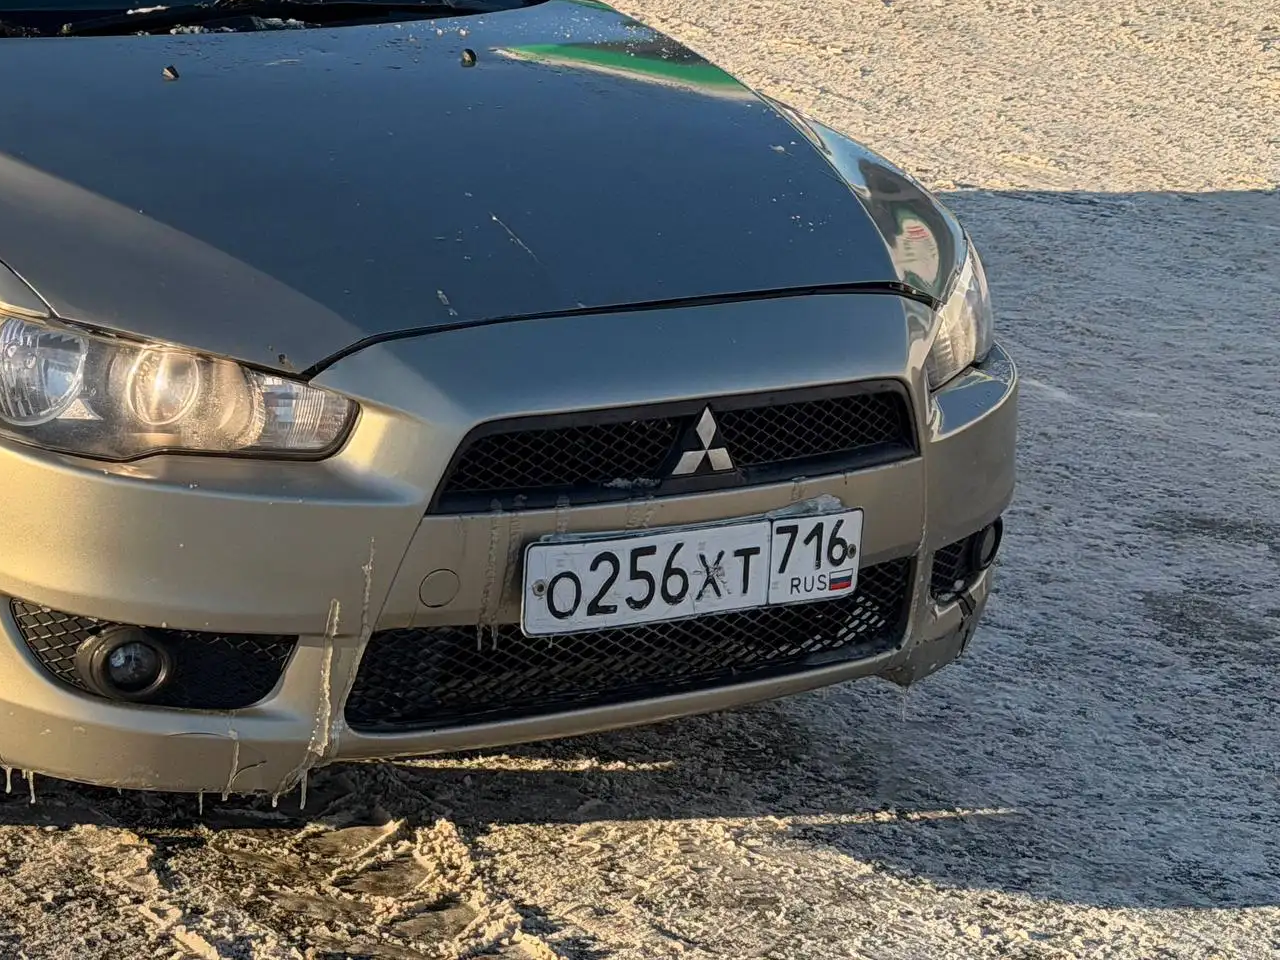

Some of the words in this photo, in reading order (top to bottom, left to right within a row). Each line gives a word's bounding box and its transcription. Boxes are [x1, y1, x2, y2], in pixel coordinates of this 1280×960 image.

[547, 543, 761, 620] О256ХТ
[776, 519, 848, 574] 716
[791, 575, 828, 594] RUS
